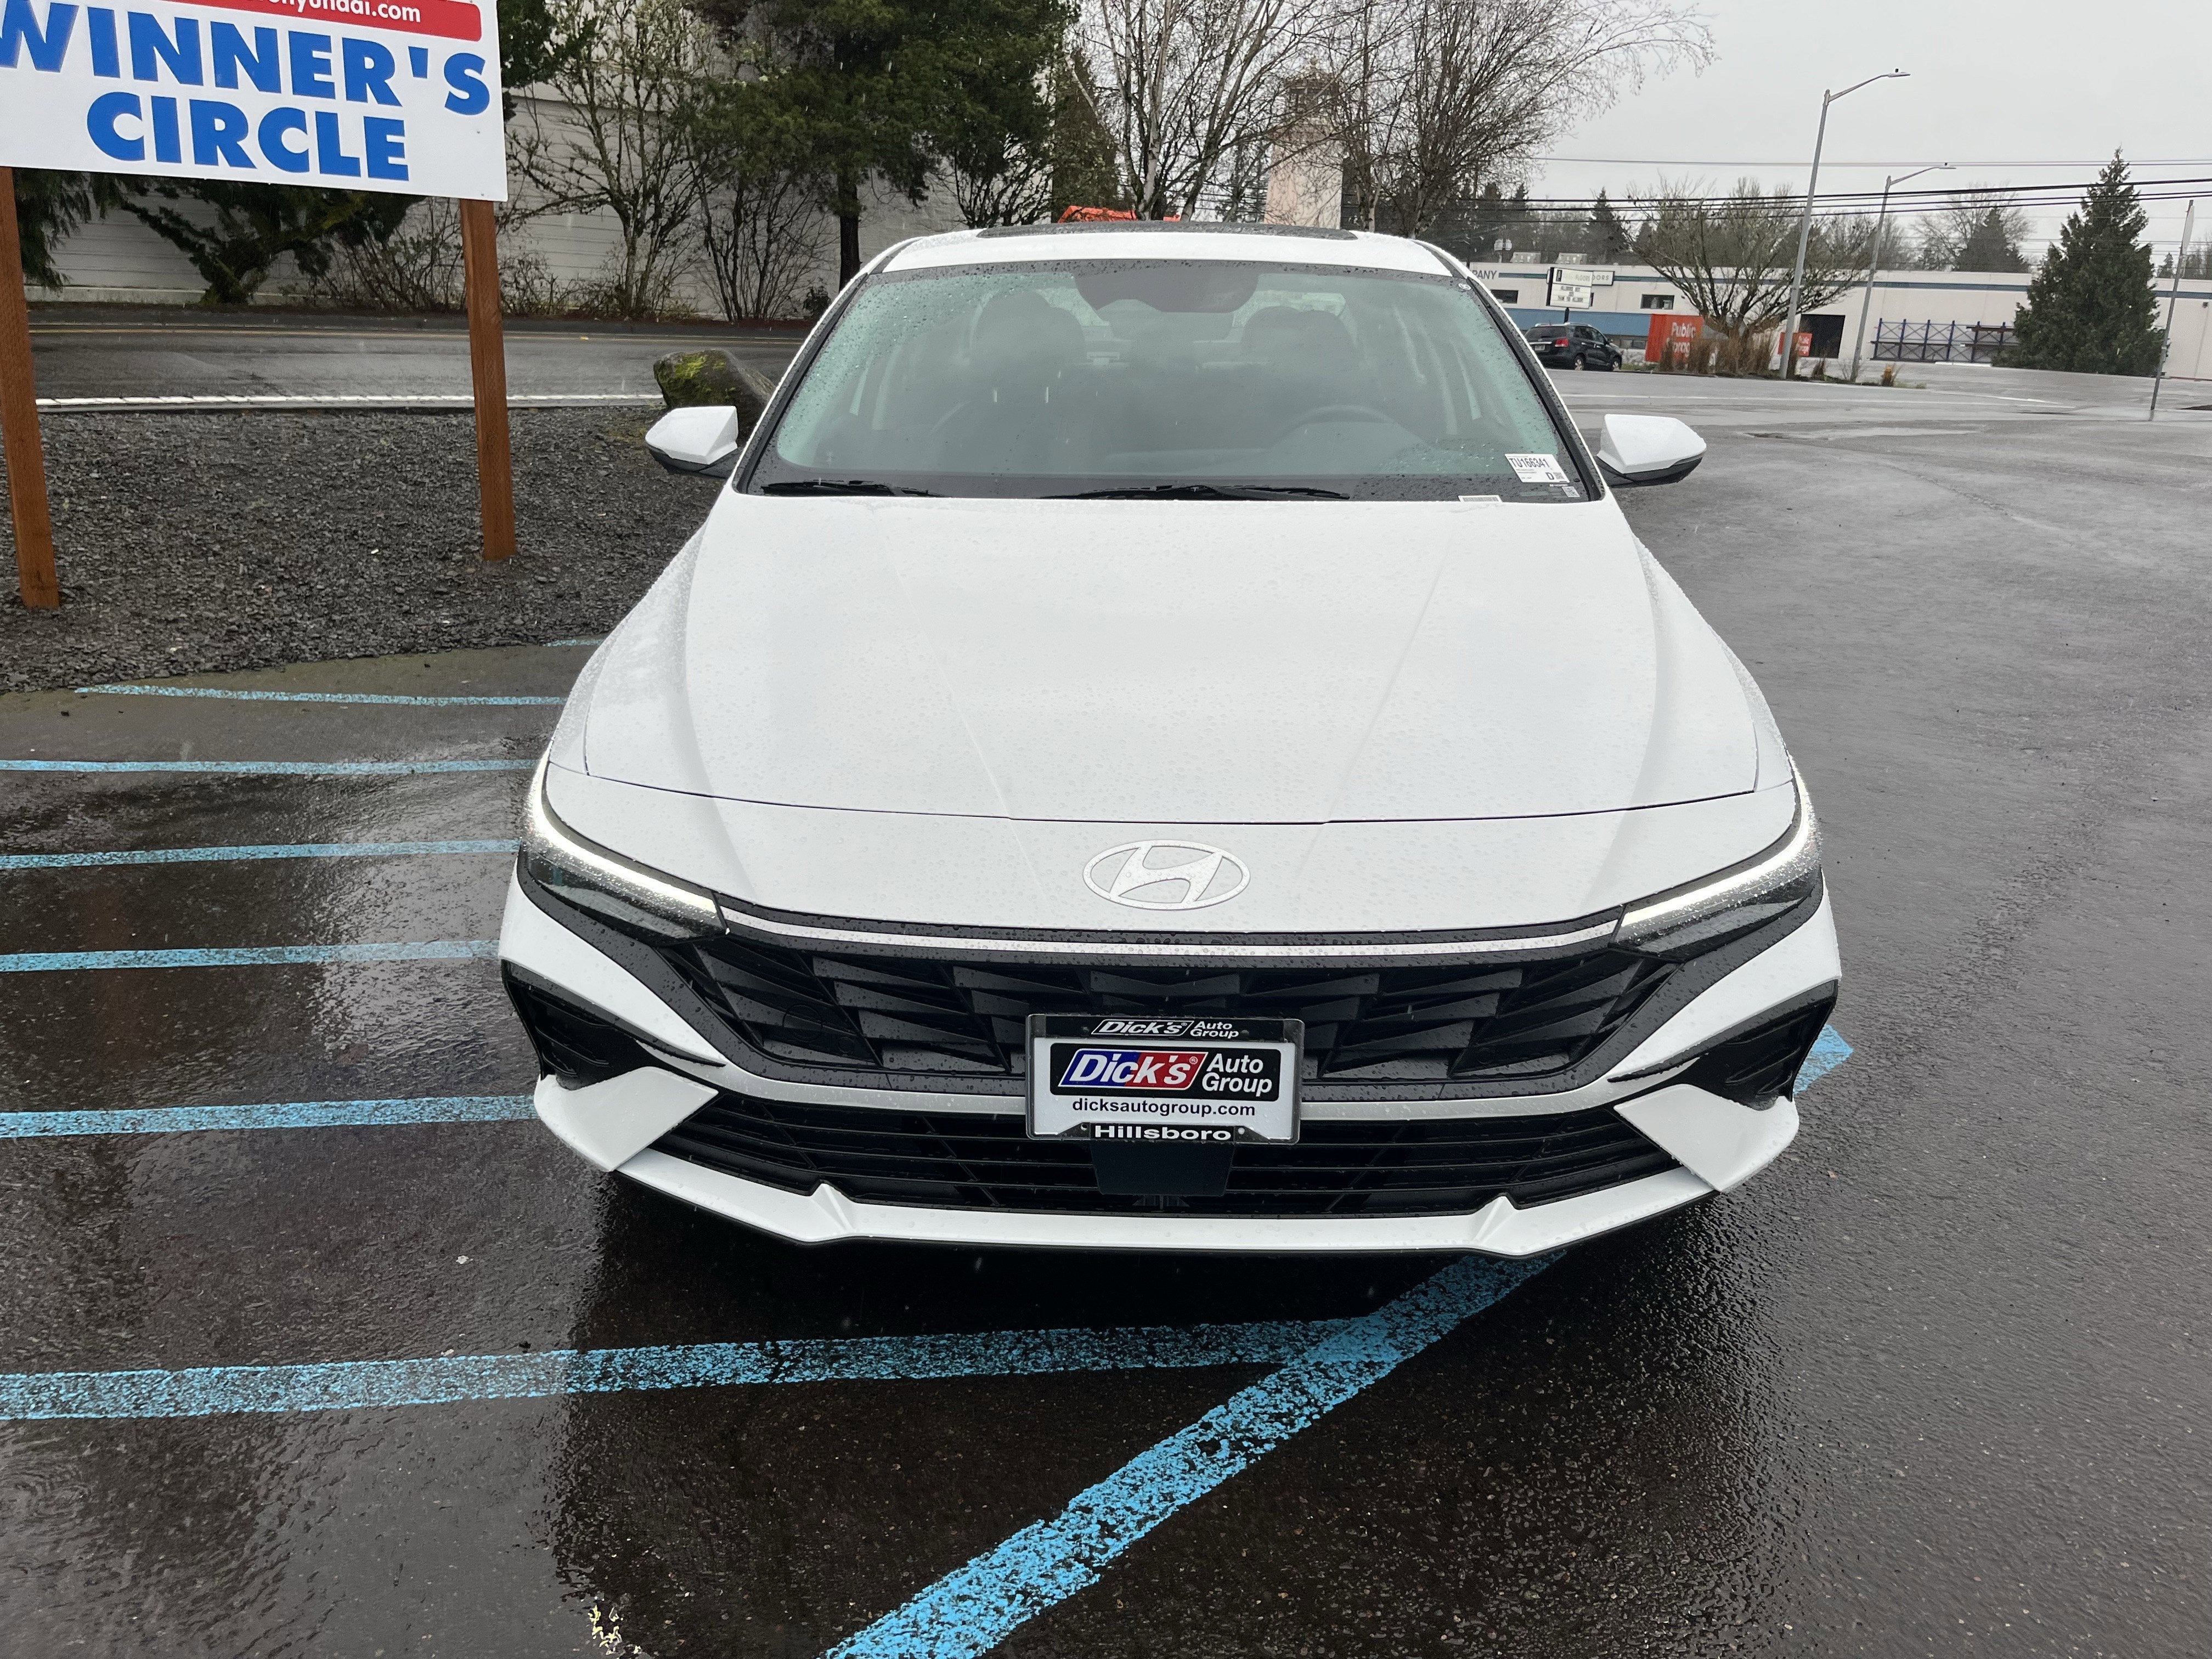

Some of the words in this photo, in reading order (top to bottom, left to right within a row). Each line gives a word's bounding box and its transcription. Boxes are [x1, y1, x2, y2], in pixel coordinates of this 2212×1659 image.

[0, 0, 490, 116] WINNER'S
[87, 92, 409, 181] CIRCLE
[1509, 458, 1550, 468] TU166341
[1190, 1029, 1239, 1039] Group
[1194, 1021, 1233, 1030] Auto
[1206, 1053, 1263, 1074] Auto
[1201, 1073, 1273, 1096] Group
[1073, 1098, 1255, 1116] dicksautogroup.com
[1094, 1125, 1232, 1141] Hillsboro
